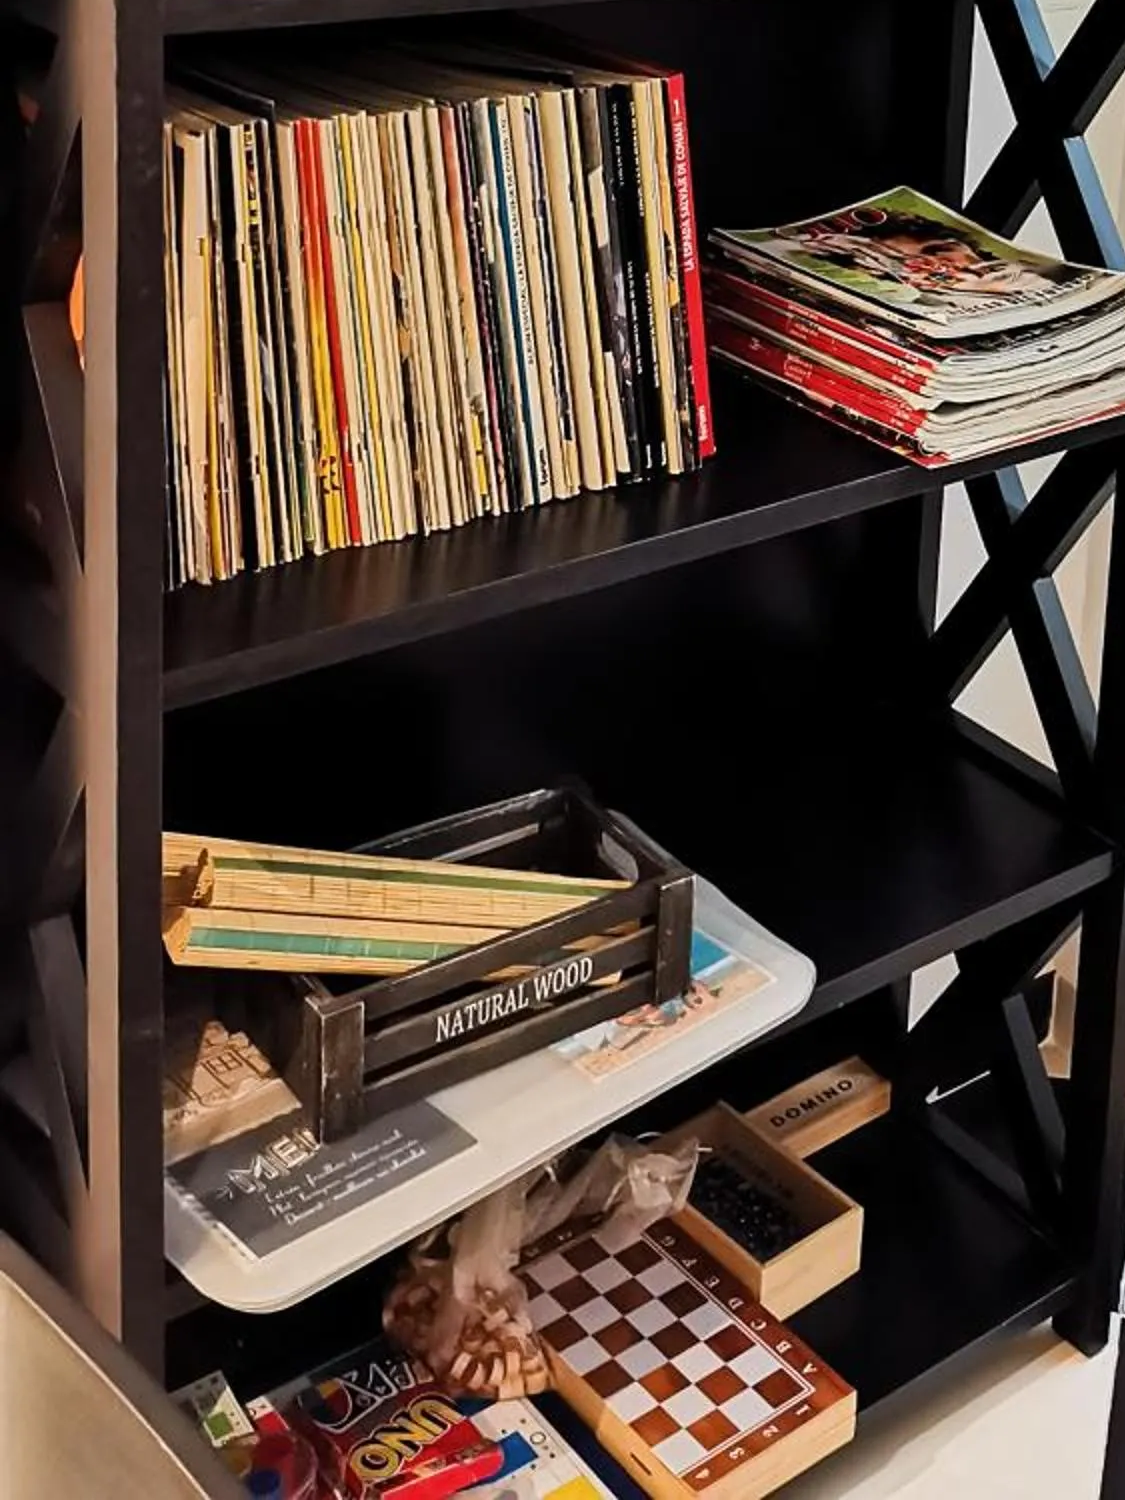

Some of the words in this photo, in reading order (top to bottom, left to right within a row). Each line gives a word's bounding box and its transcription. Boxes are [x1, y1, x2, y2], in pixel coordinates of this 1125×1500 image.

[672, 121, 686, 161] CONAN
[675, 161, 688, 175] DE
[676, 174, 691, 219] SALVAJE
[680, 219, 695, 258] ESPADA
[685, 258, 697, 273] LA
[435, 991, 530, 1044] NATURAL
[533, 956, 594, 1002] WOOD
[770, 1079, 853, 1128] DOMINO
[350, 1393, 466, 1482] UNO
